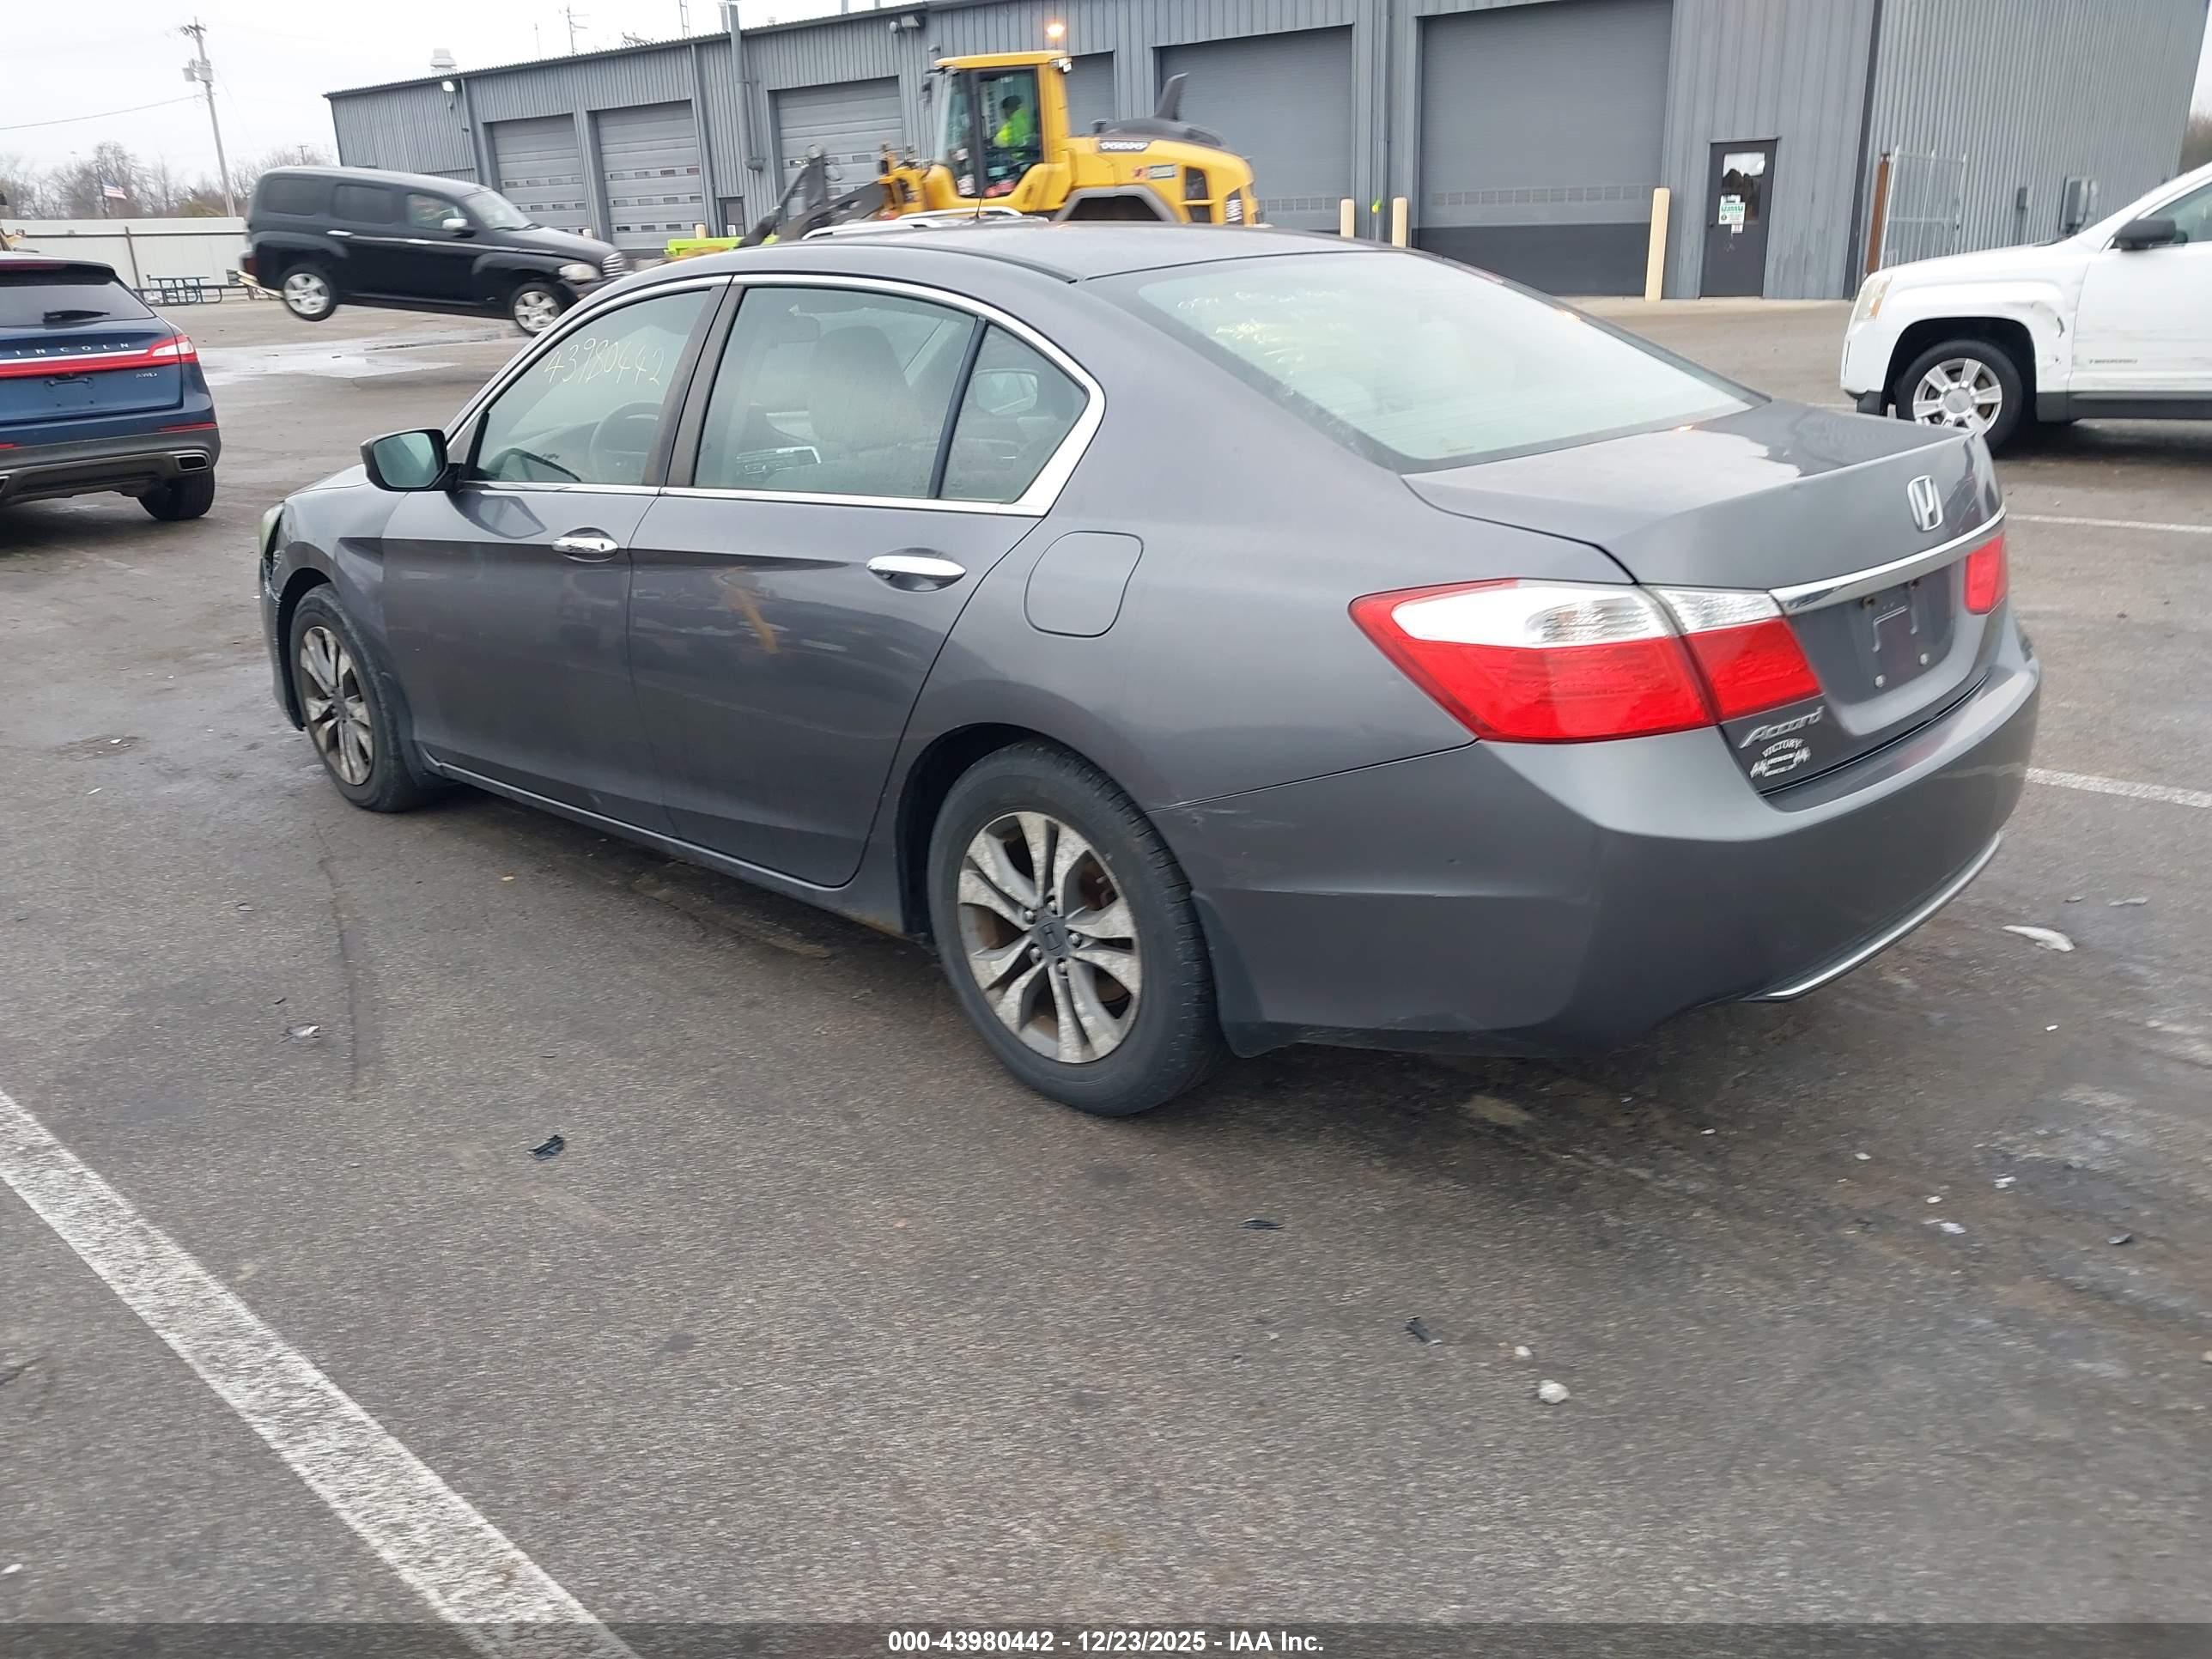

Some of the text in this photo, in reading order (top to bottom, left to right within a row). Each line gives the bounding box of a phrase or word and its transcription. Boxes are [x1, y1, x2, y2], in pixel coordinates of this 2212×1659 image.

[0, 343, 129, 357] INCOLN
[544, 337, 666, 386] 43980442
[1738, 705, 1825, 749] Accord
